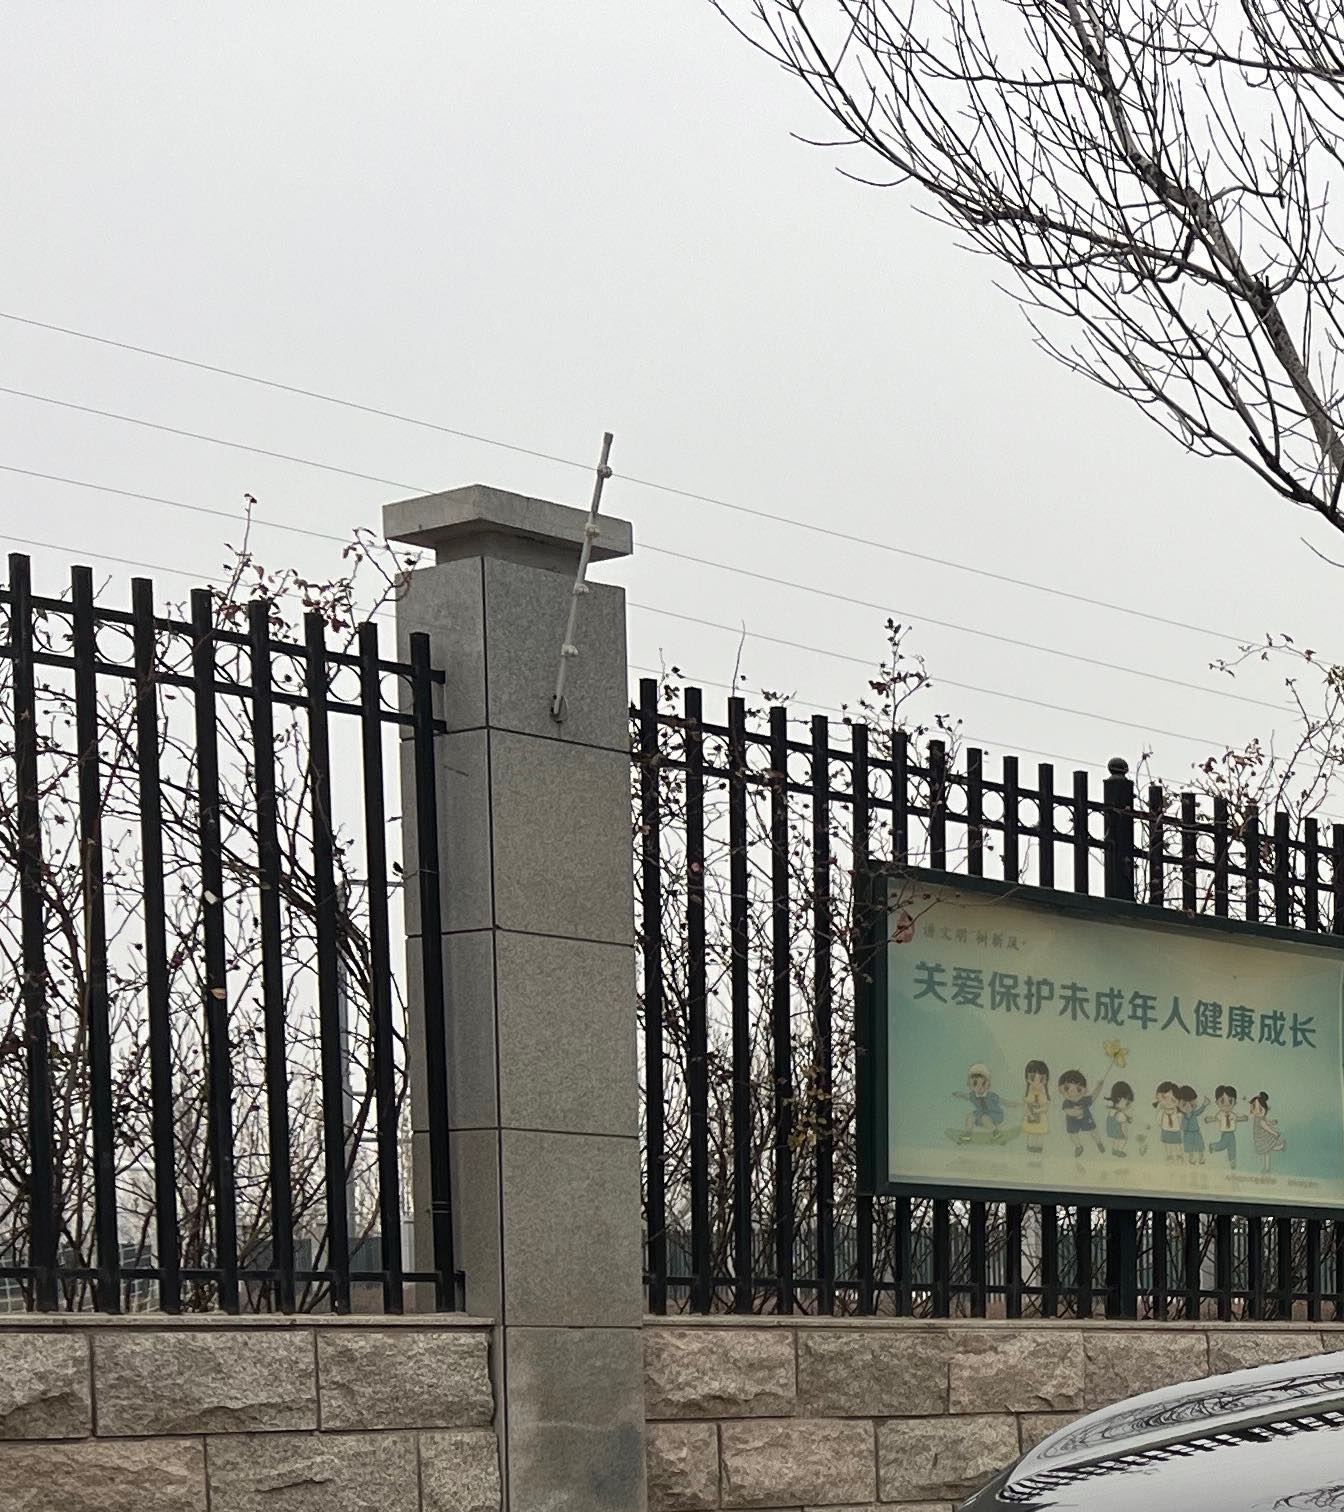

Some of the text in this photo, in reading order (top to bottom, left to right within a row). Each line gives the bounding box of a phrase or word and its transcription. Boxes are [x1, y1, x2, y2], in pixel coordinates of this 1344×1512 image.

[911, 961, 1318, 1050] 关爱保护未成年人健康成长
